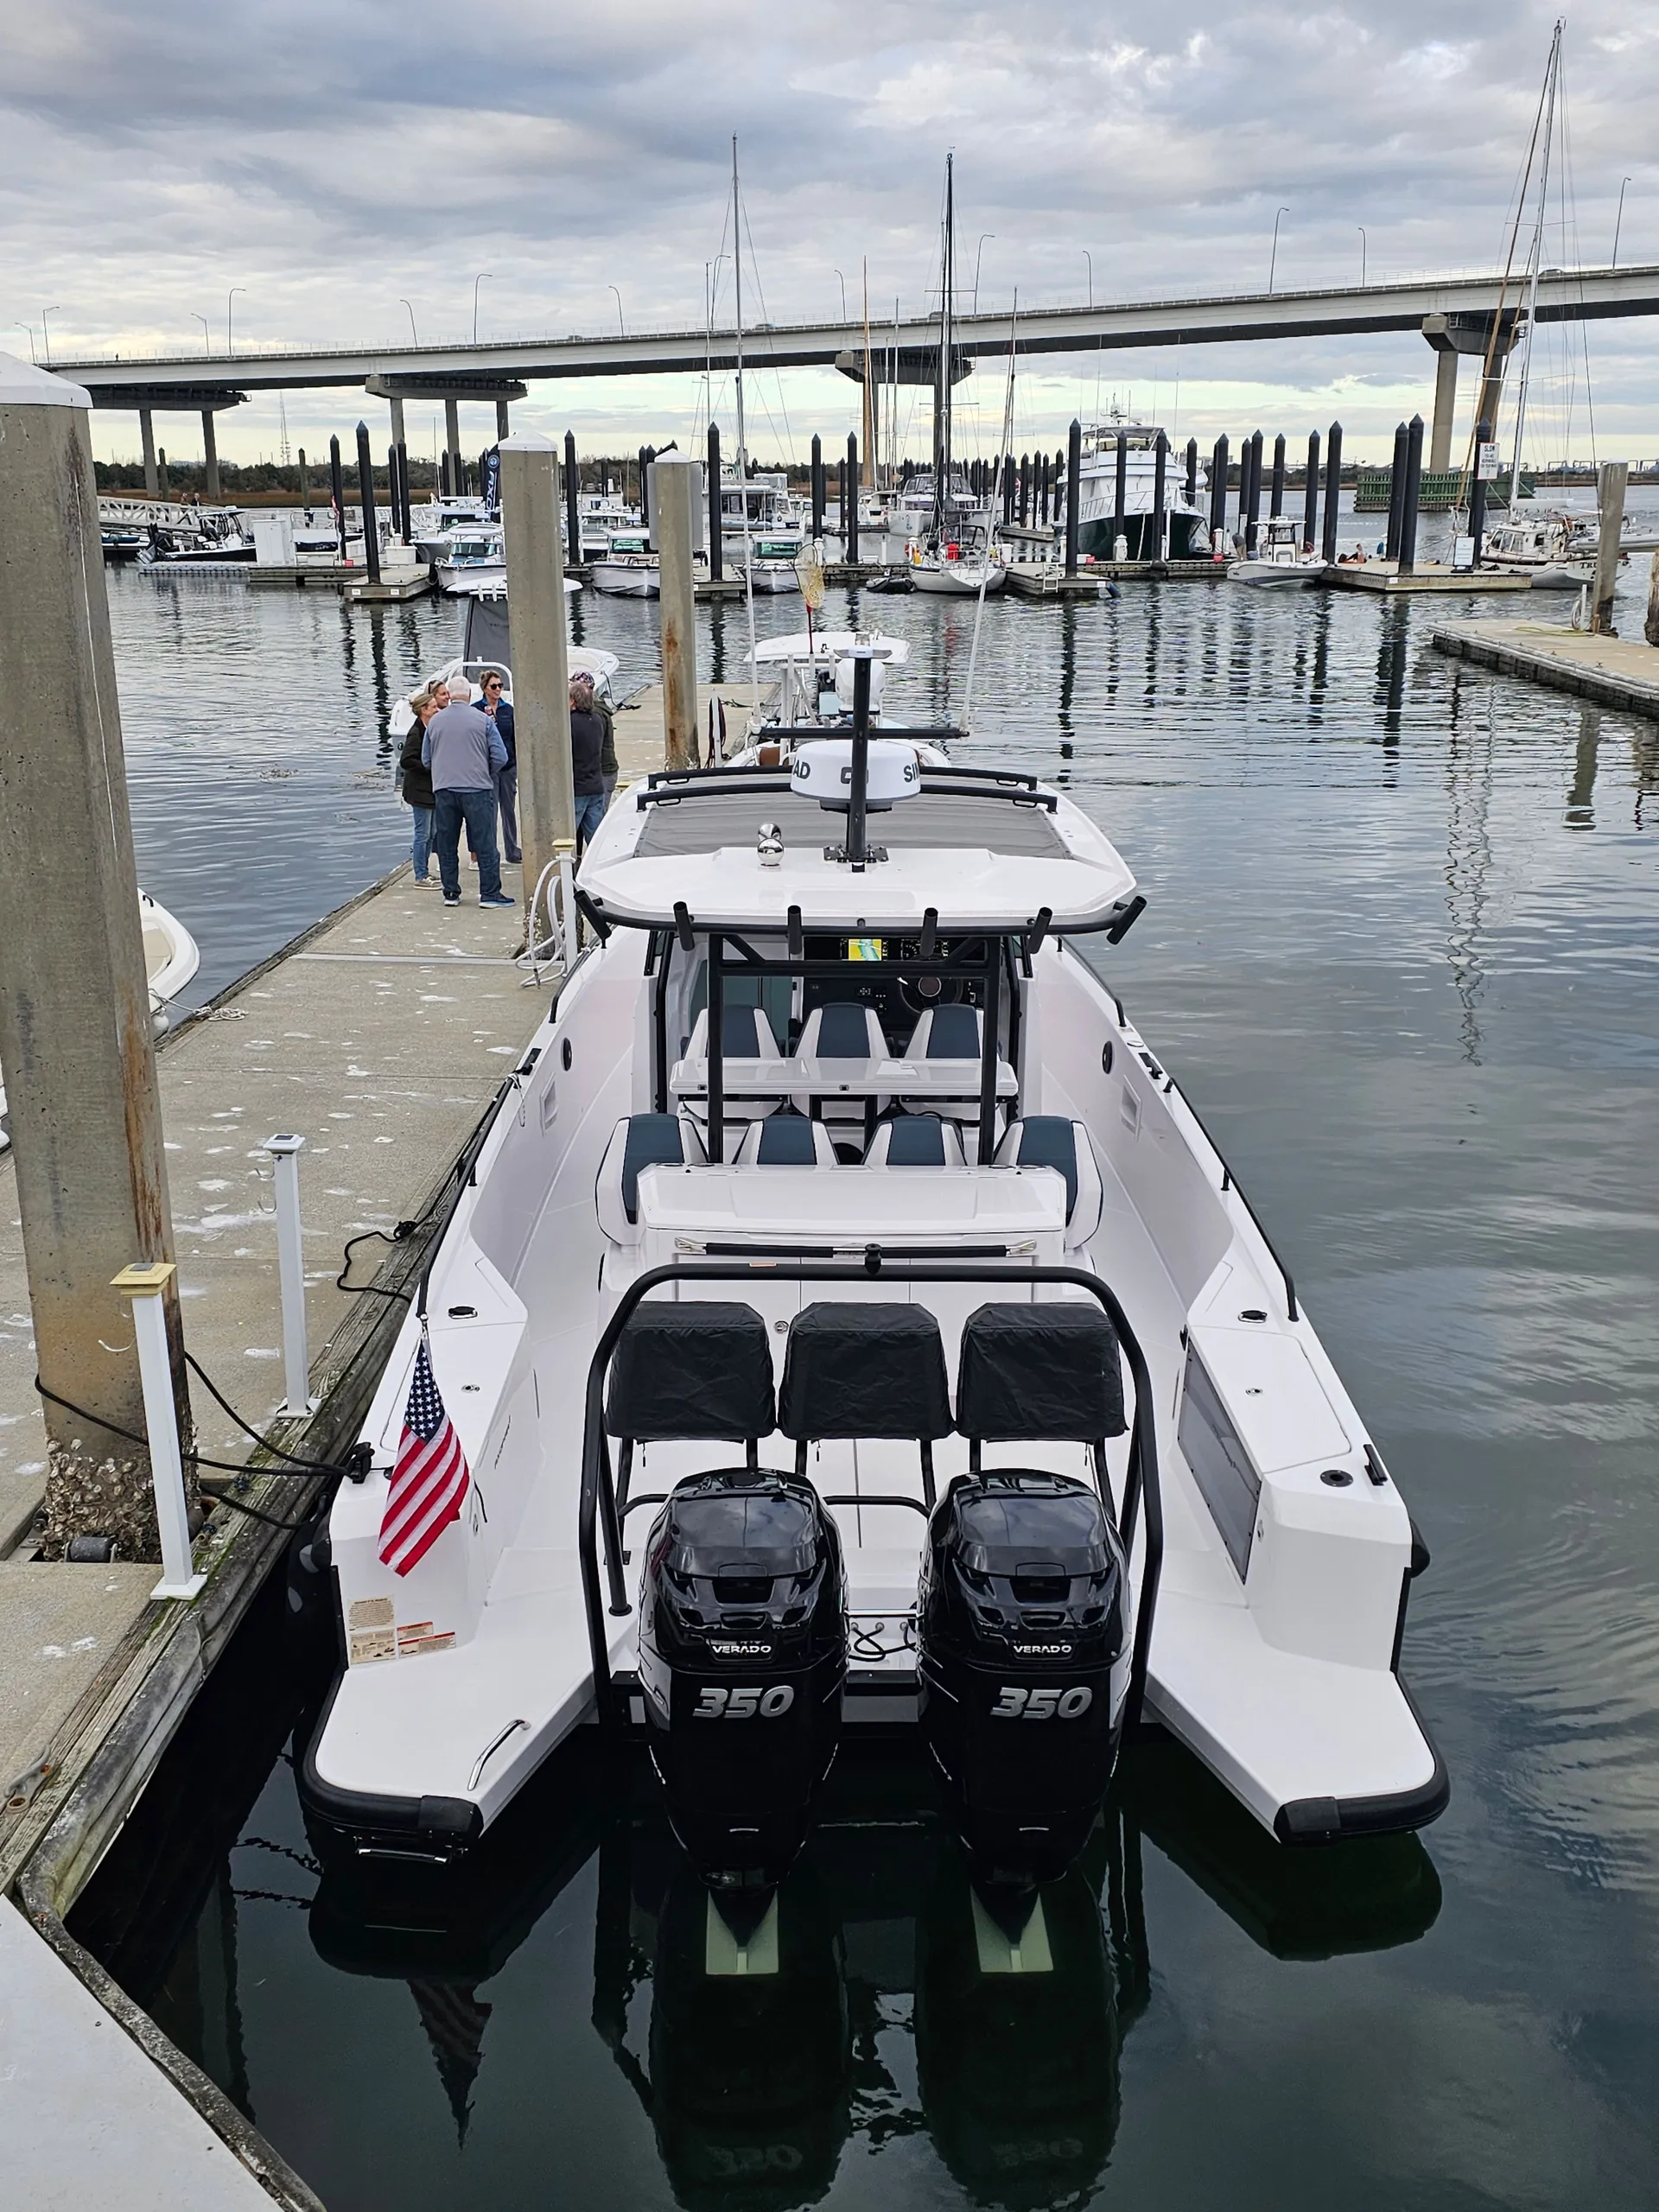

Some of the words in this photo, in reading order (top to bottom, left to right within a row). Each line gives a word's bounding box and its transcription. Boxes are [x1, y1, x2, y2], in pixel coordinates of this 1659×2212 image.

[792, 759, 810, 779] AD
[712, 1645, 772, 1654] VERADO
[1013, 1645, 1072, 1654] VERADO
[692, 1685, 794, 1719] 350
[989, 1687, 1093, 1719] 350
